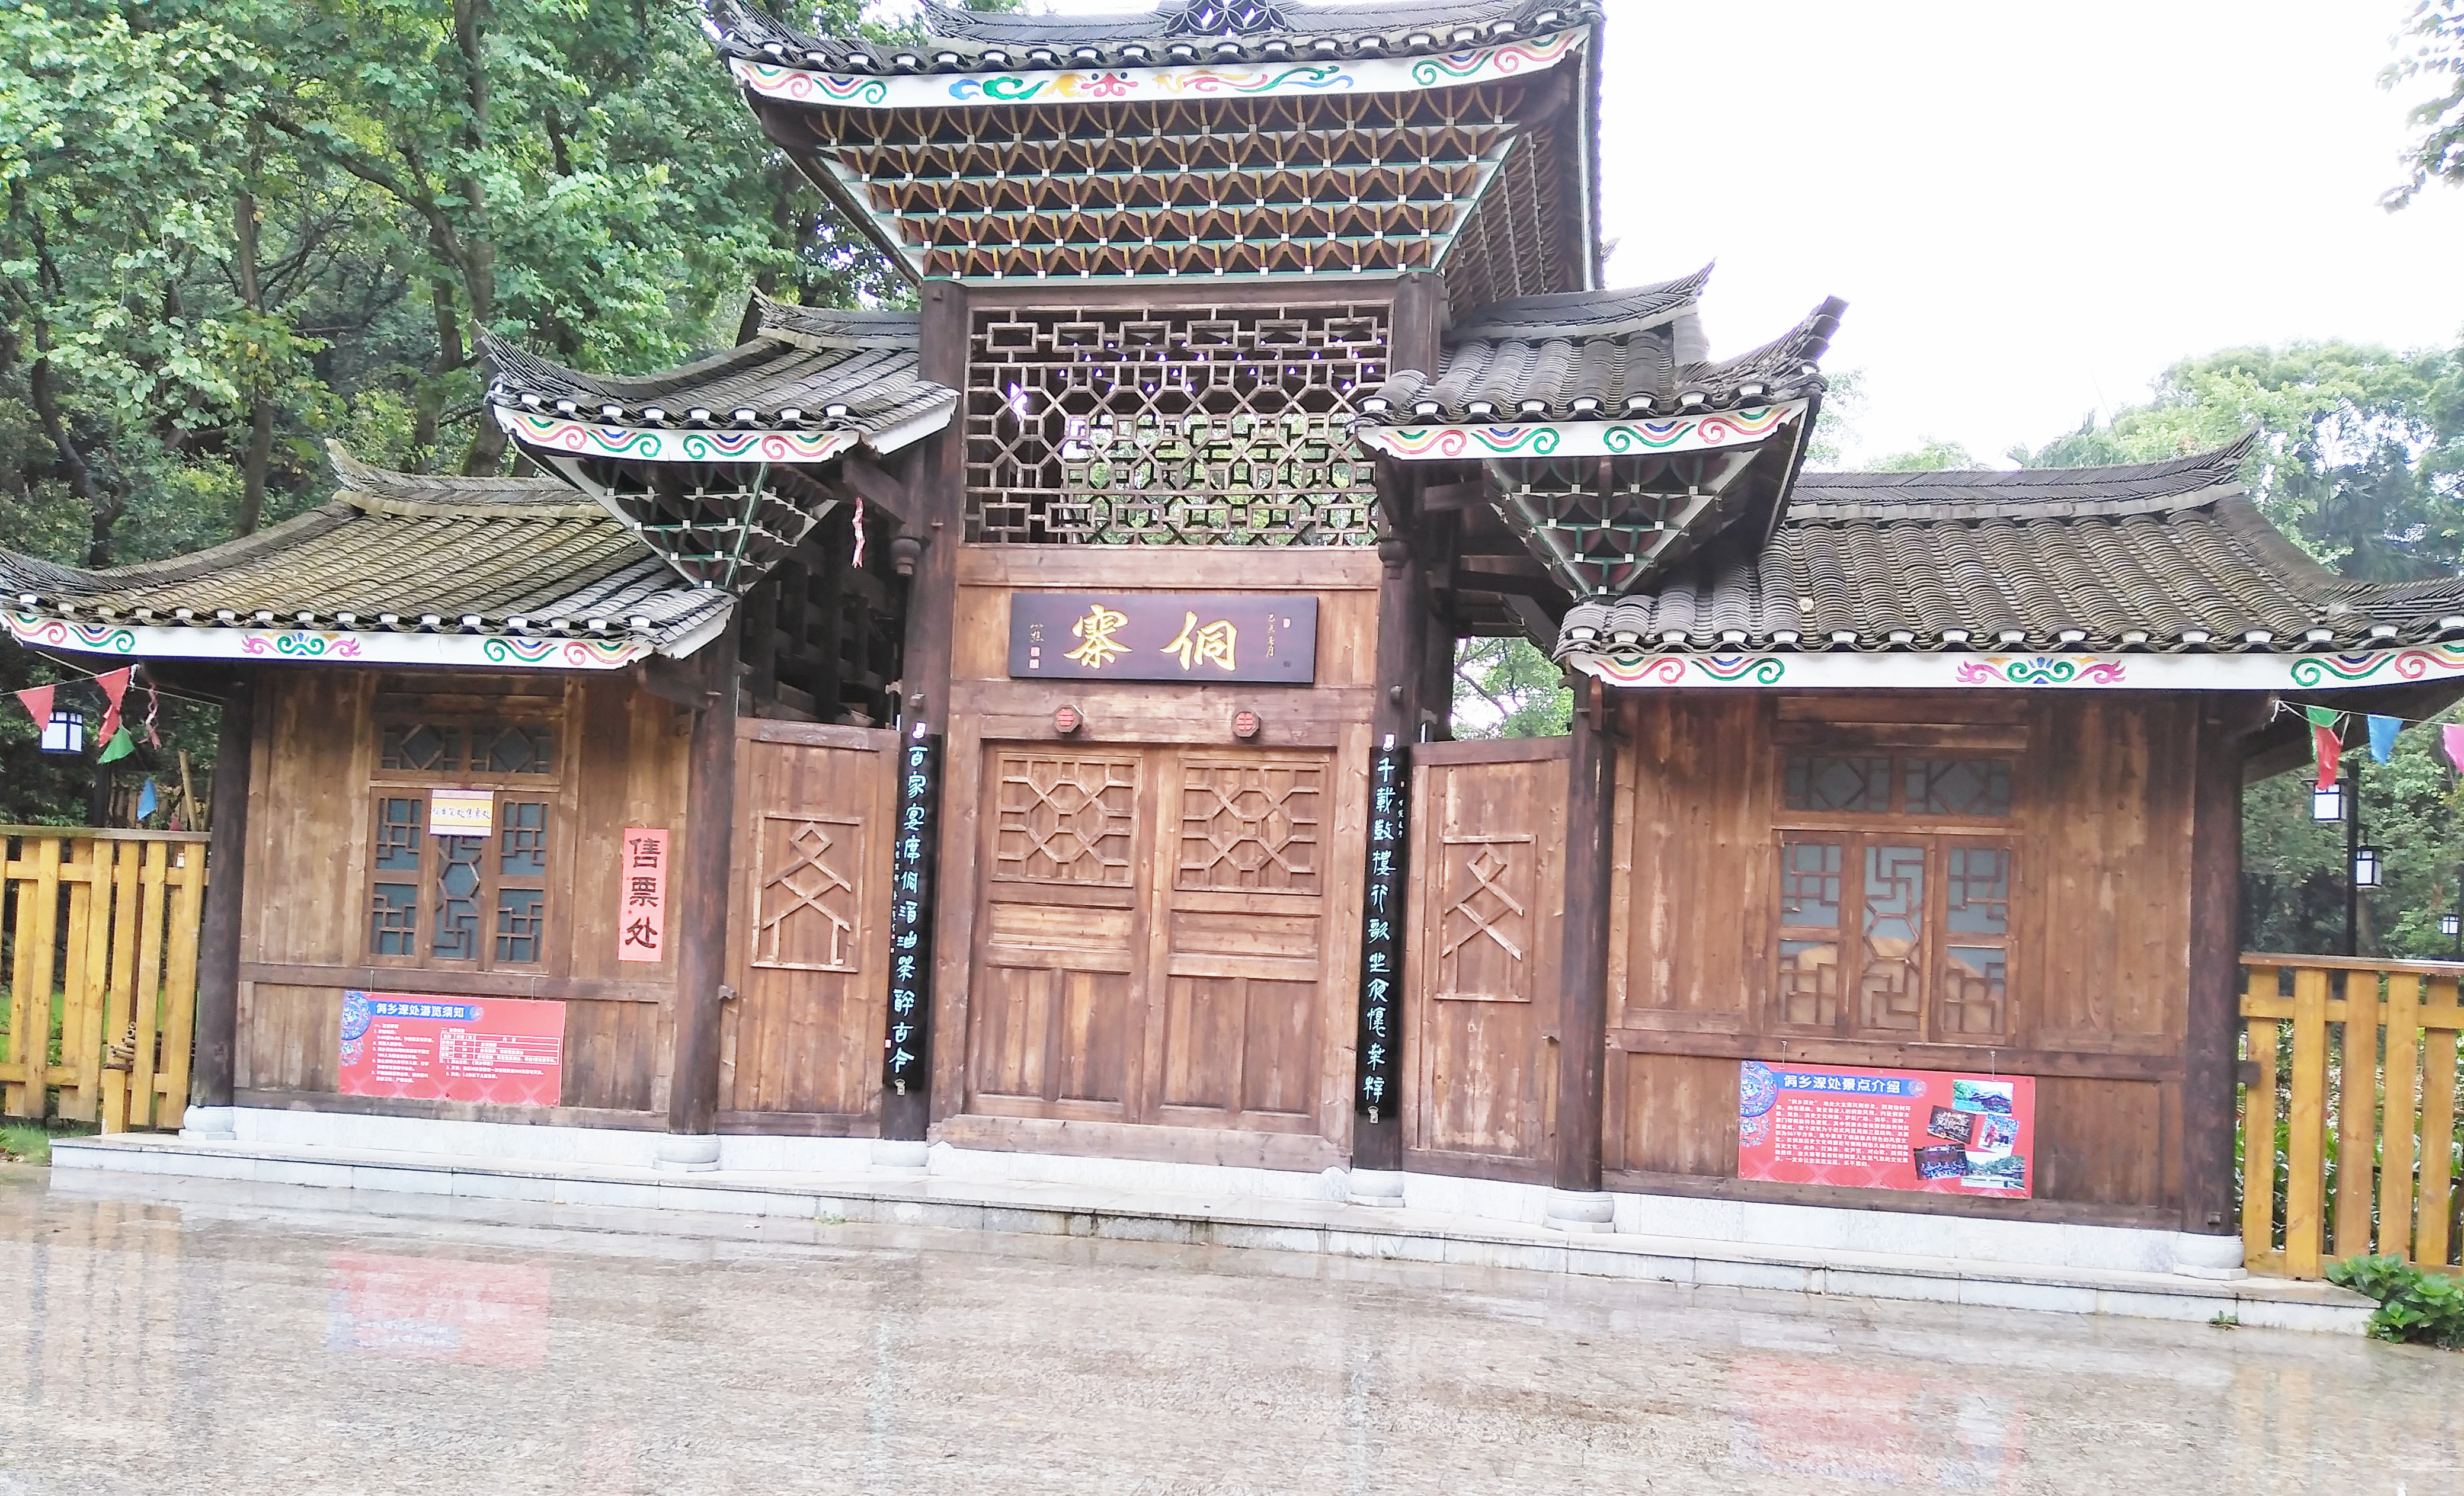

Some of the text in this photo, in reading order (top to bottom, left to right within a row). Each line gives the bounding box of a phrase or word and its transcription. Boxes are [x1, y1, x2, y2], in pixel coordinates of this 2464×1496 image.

[625, 837, 661, 949] 售票处
[376, 1003, 465, 1018] 侗乡深处游览须知
[1784, 1075, 1900, 1094] 侗乡深处景点介绍
